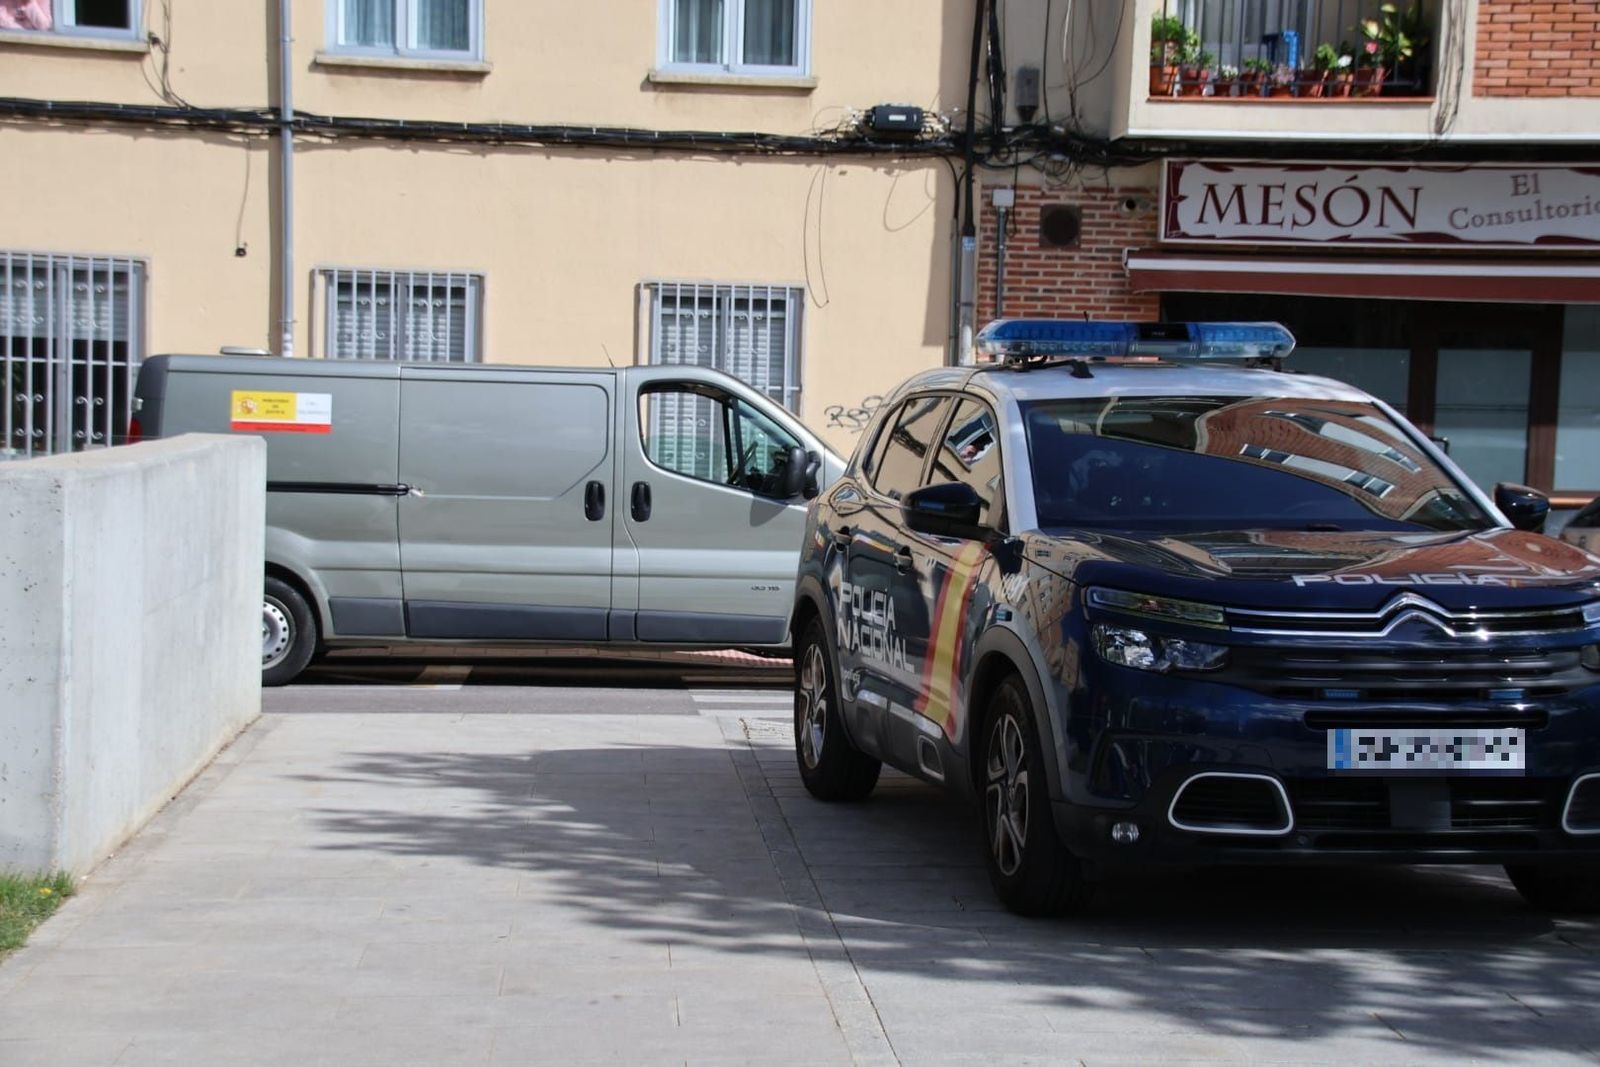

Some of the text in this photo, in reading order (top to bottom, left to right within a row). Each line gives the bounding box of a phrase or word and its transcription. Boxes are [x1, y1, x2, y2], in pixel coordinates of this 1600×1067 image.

[1198, 174, 1424, 231] MESÓN
[1510, 173, 1541, 197] El
[837, 617, 915, 673] NACIONAL
